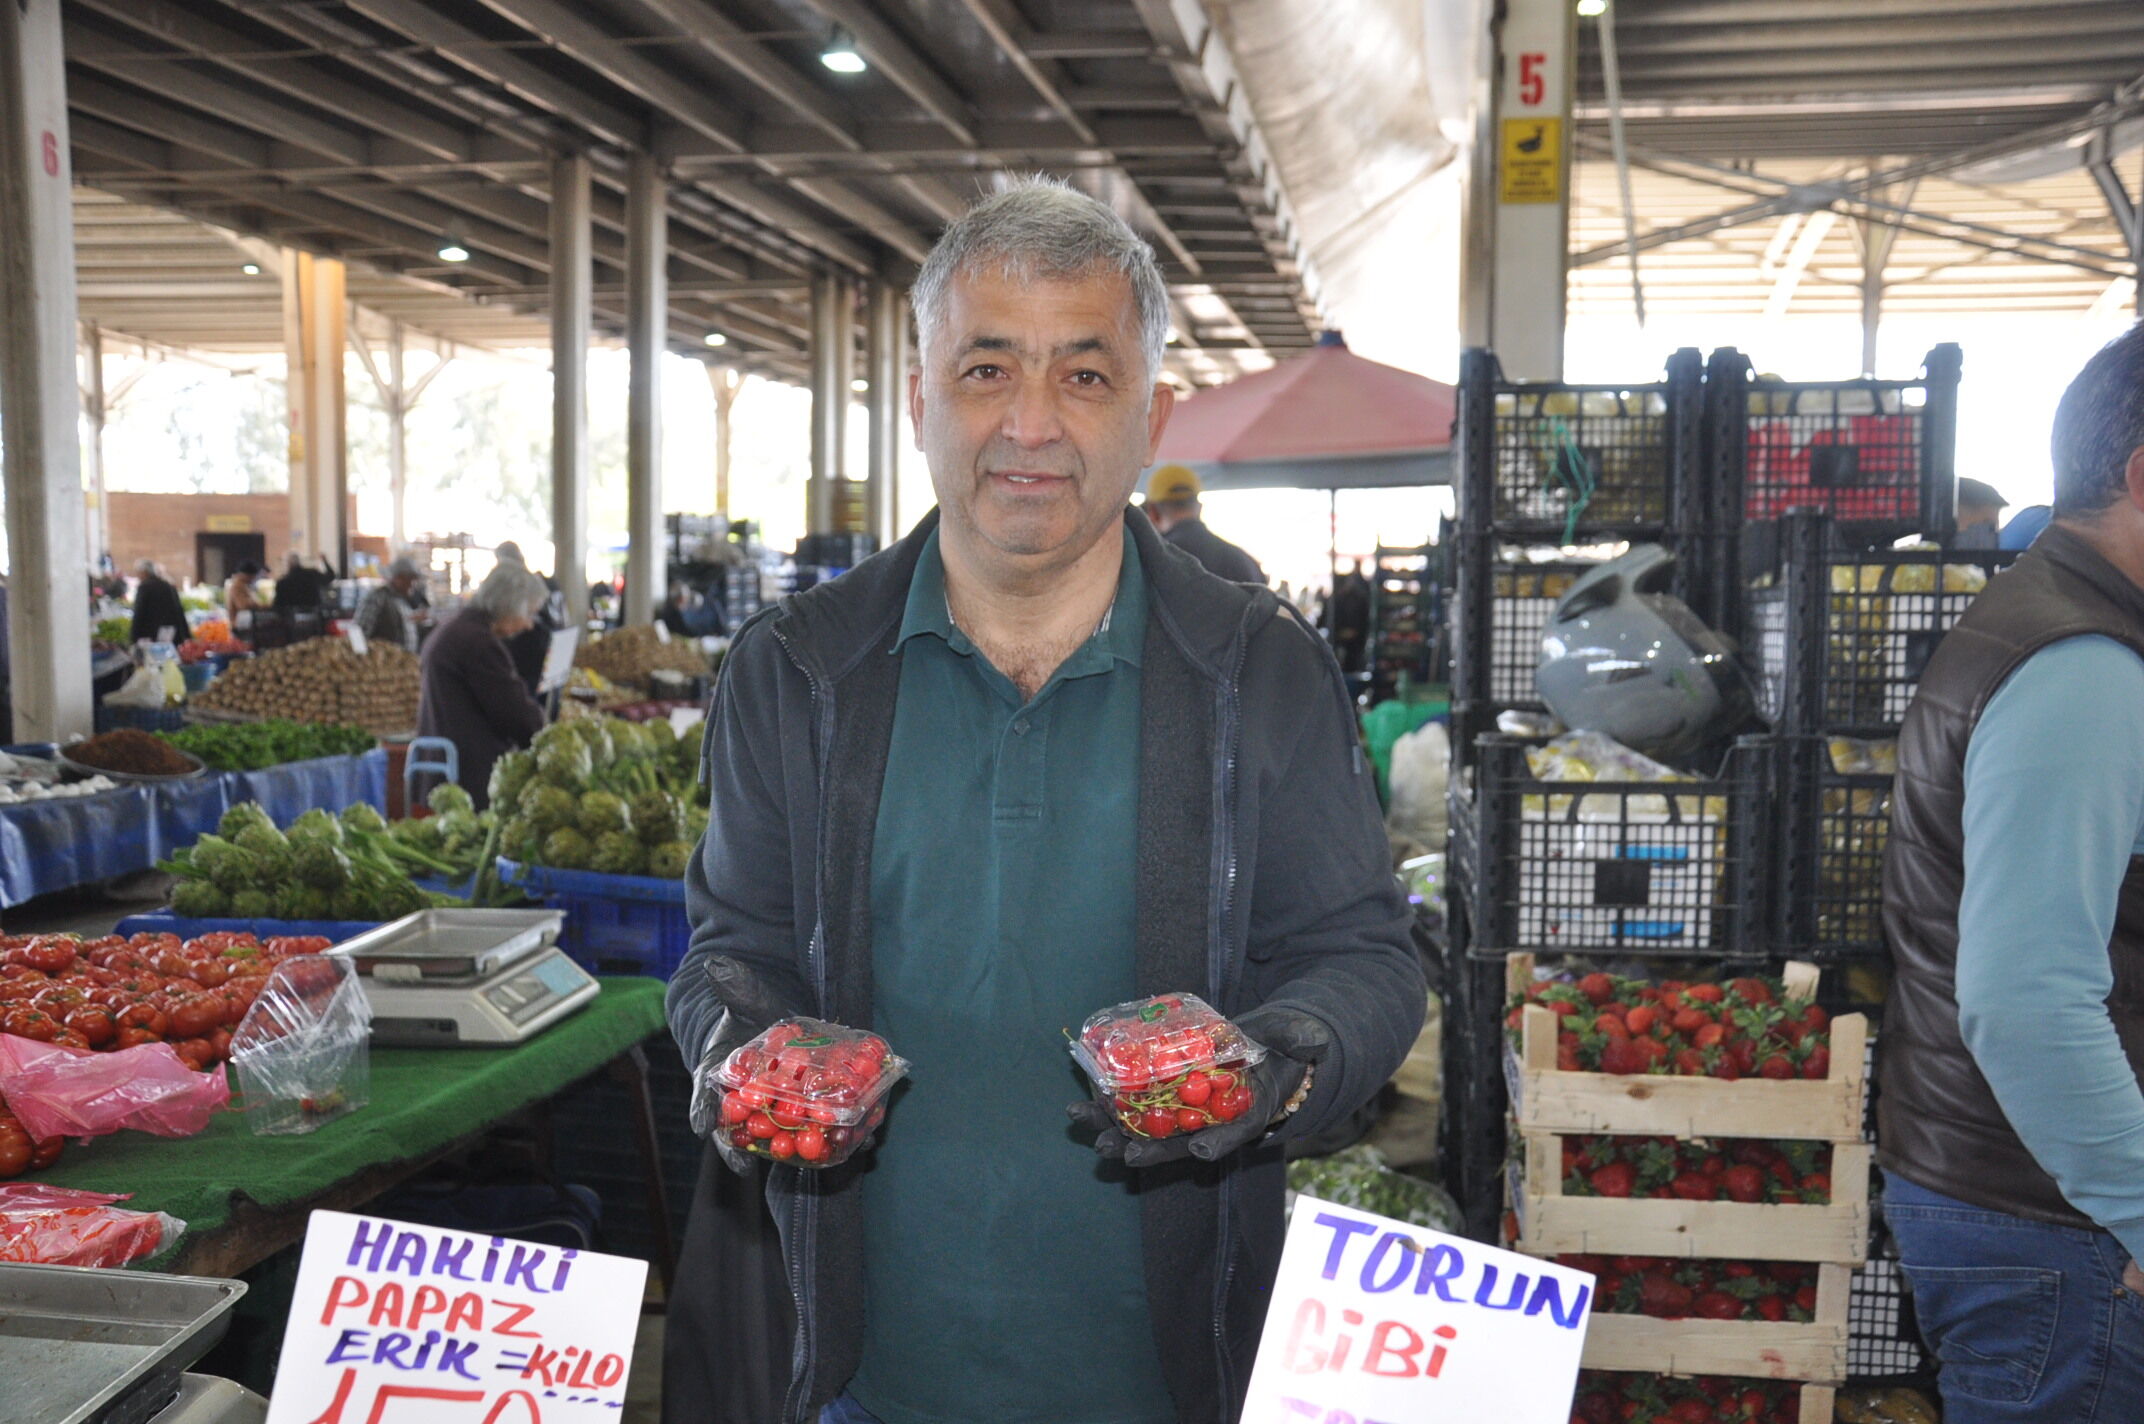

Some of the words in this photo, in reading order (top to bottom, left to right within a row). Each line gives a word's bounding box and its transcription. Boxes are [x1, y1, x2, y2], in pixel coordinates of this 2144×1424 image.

[1519, 53, 1546, 106] 5
[1314, 1211, 1590, 1330] TORUN
[319, 1276, 543, 1338] PAPAZ
